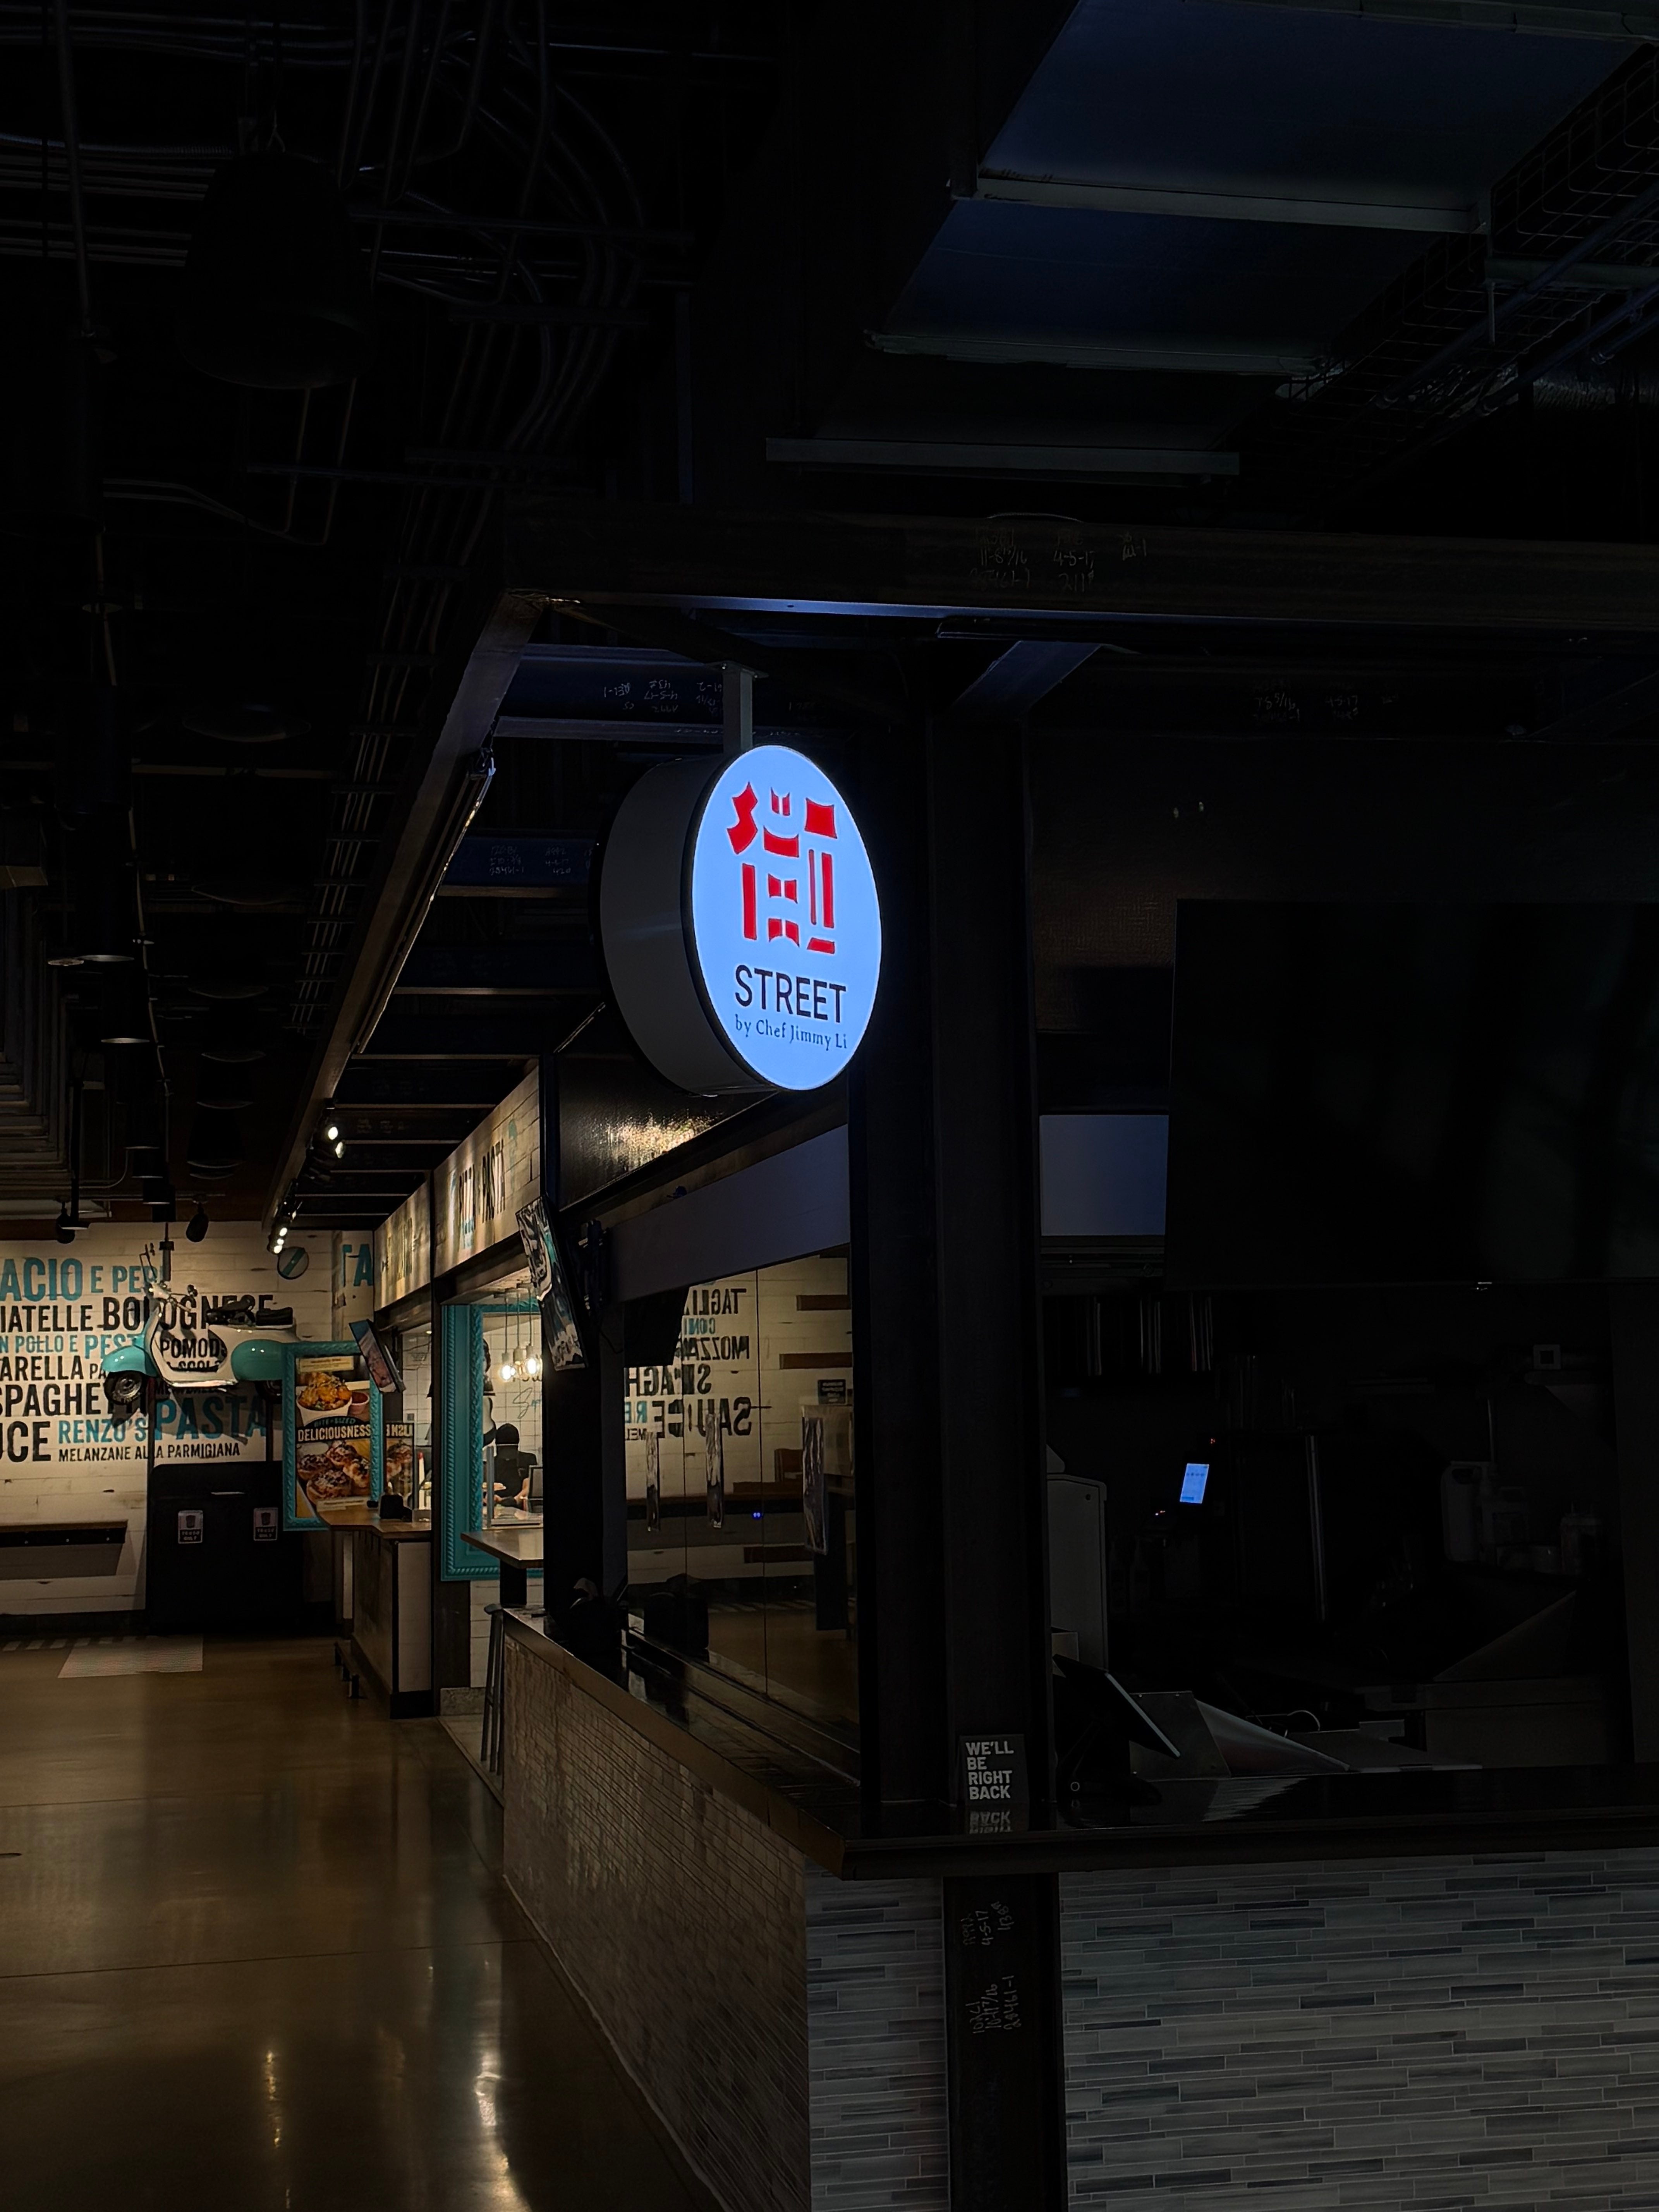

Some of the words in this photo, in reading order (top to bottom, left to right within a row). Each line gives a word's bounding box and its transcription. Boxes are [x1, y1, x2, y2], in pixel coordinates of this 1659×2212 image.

[734, 964, 847, 1024] STREET
[735, 1014, 751, 1038] by
[756, 1018, 786, 1039] Chef
[789, 1023, 832, 1052] Jimmy
[835, 1033, 848, 1049] Li
[0, 1257, 83, 1302] ACIO
[91, 1266, 103, 1293] E
[113, 1265, 163, 1293] PEP
[0, 1305, 93, 1332] IATELLE
[103, 1295, 273, 1331] BOLOGNE
[16, 1335, 64, 1353] POLLO
[70, 1335, 77, 1352] E
[85, 1334, 136, 1359] PES
[0, 1356, 83, 1381] ARELLA
[0, 1384, 146, 1416] PAGHEI
[59, 1419, 148, 1444] RENZO'S
[156, 1396, 266, 1441] PASTA
[297, 1424, 371, 1442] DELICIOUSNESS
[58, 1447, 131, 1462] MELANZANE
[168, 1443, 240, 1458] PARMIGIANA
[965, 1740, 1015, 1756] WE'LL
[967, 1756, 988, 1771] BE
[968, 1770, 1013, 1785] RIGHT
[969, 1784, 1011, 1800] BACK
